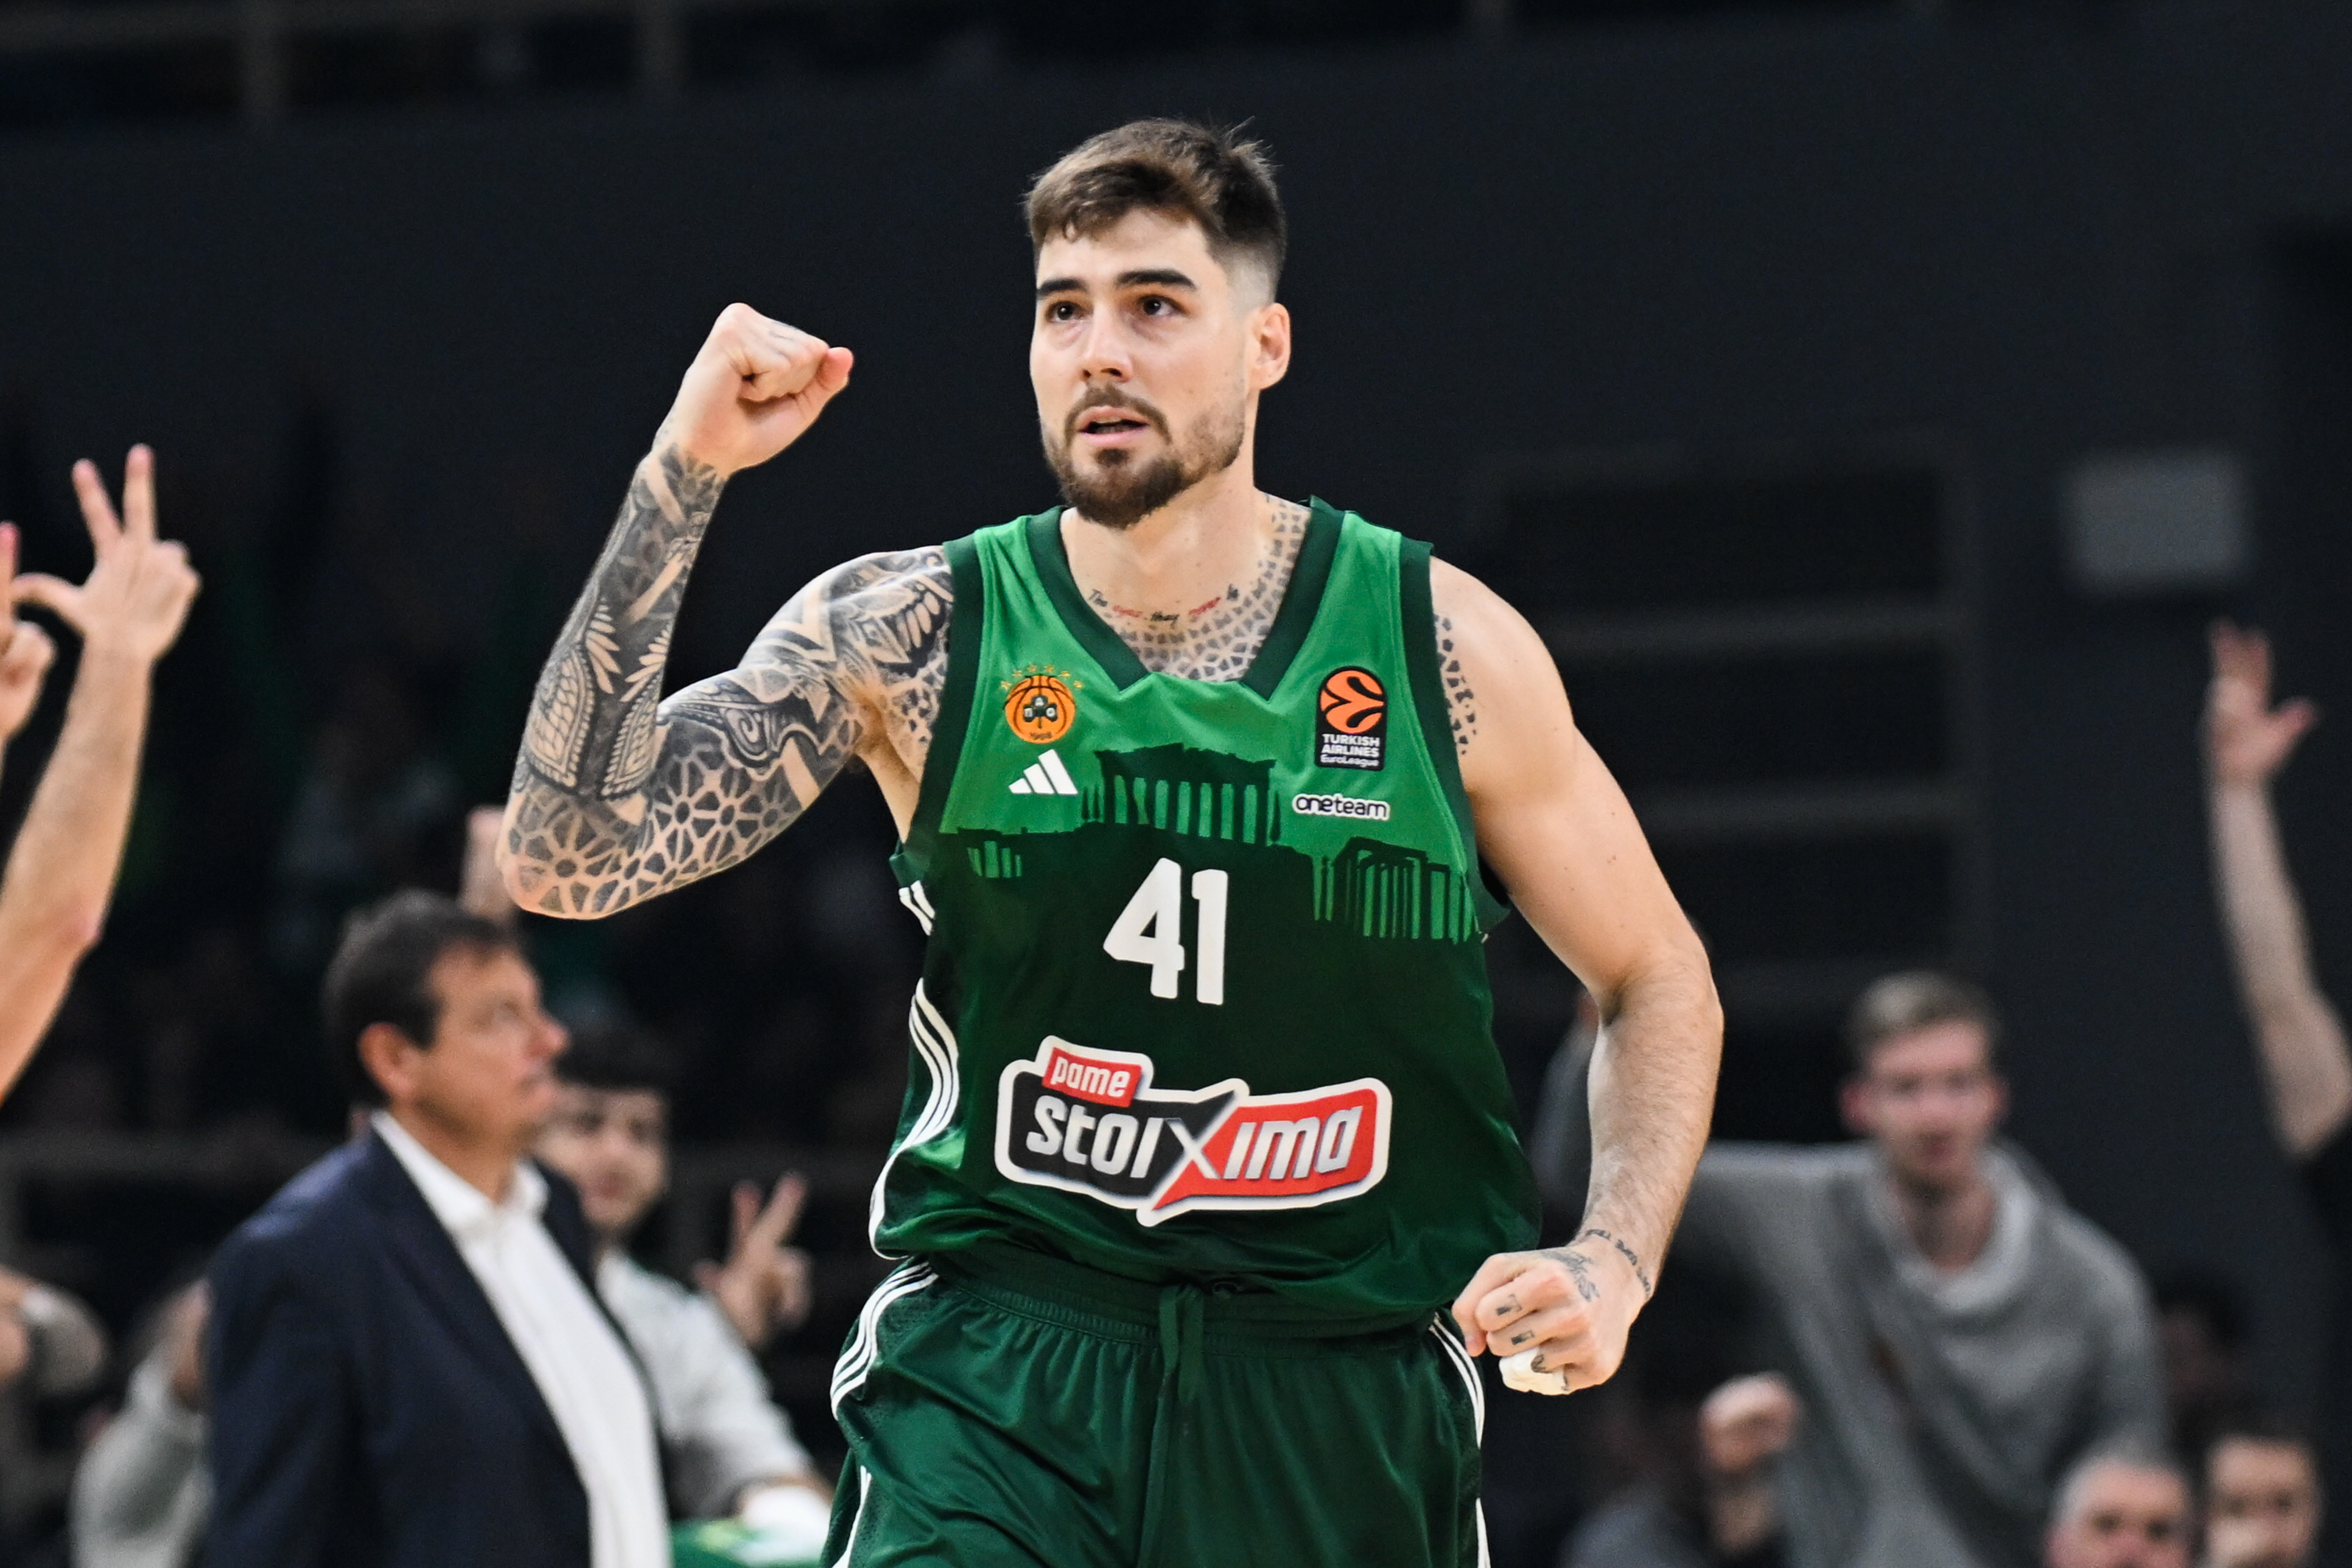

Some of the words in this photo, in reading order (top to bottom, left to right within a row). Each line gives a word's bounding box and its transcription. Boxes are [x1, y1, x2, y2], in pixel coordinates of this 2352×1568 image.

[1321, 733, 1380, 747] TURKISH
[1321, 744, 1380, 758] AIRLINES
[1320, 754, 1379, 767] EuroLeague
[1296, 796, 1387, 817] oneteam
[1103, 858, 1228, 1005] 41
[1050, 1056, 1132, 1097] pame
